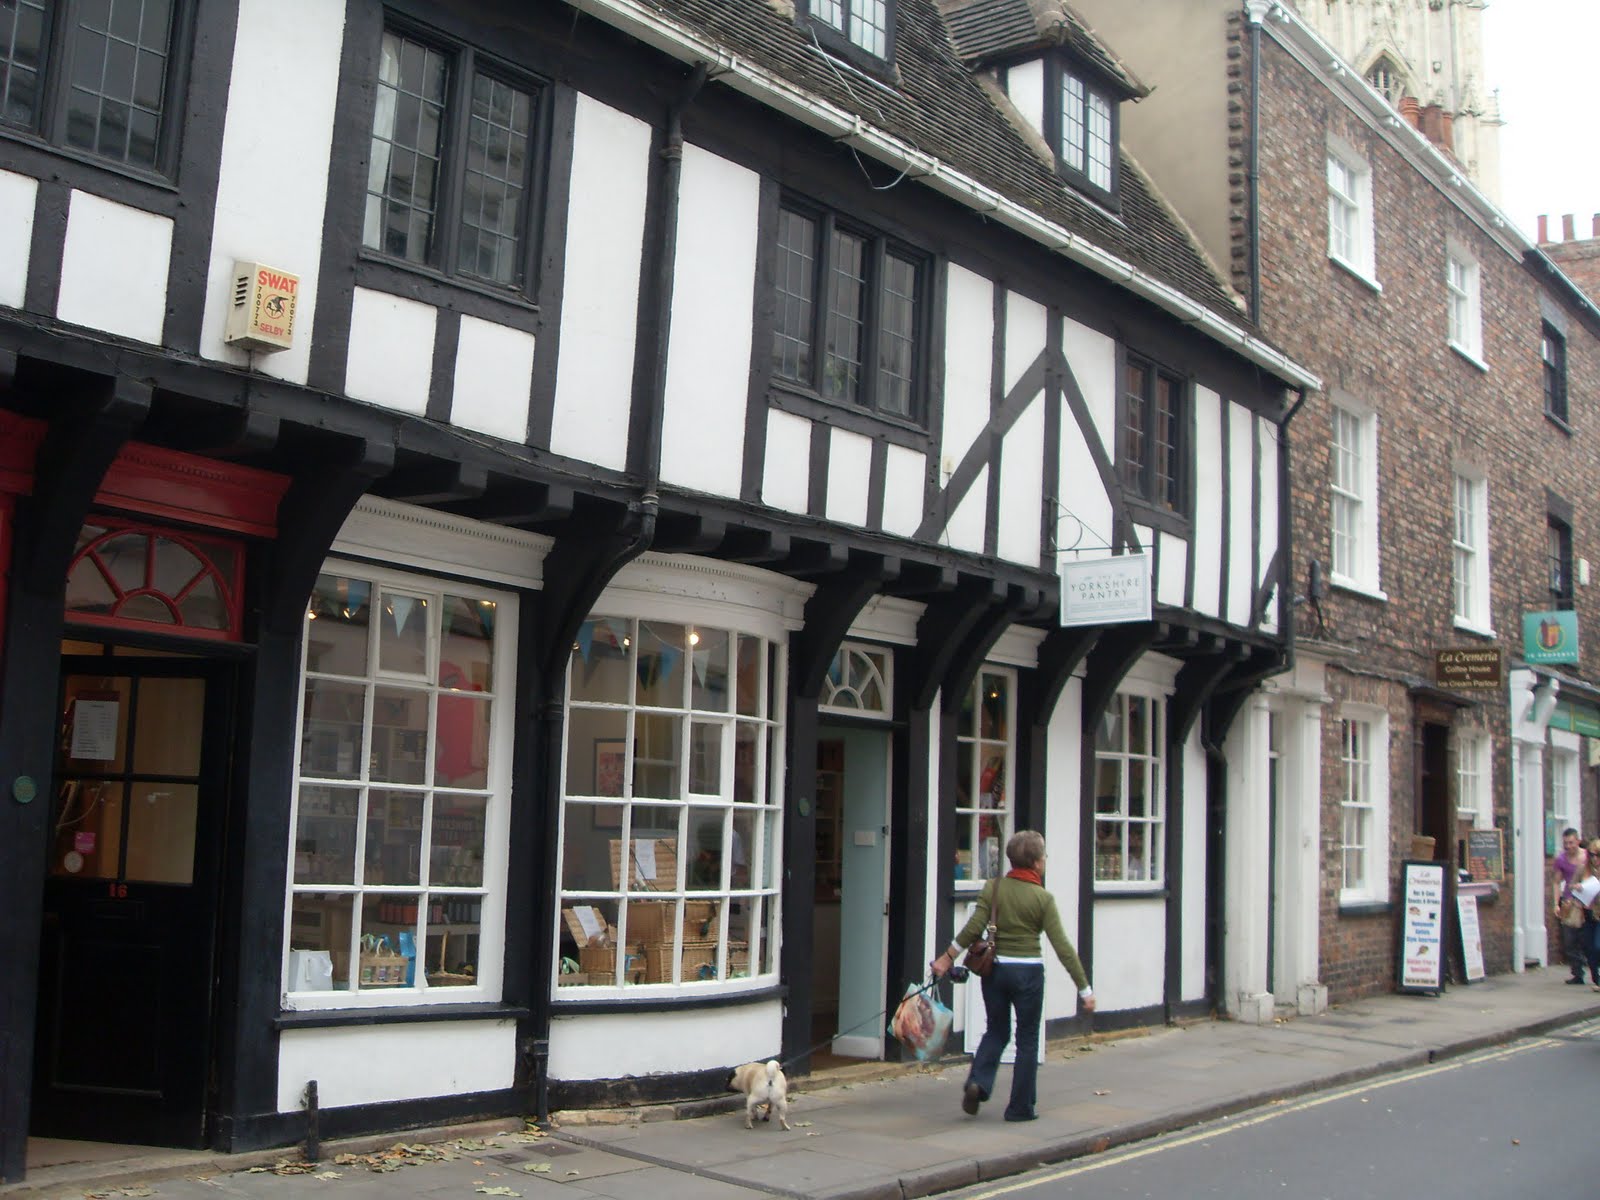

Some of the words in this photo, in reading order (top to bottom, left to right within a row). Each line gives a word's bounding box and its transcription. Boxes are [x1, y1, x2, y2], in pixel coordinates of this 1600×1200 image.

[258, 270, 297, 294] SWAT
[259, 322, 285, 336] SELBY
[1071, 578, 1139, 592] YORKSHIRE
[1081, 589, 1127, 600] PANTRY
[1439, 652, 1453, 662] La
[1454, 651, 1498, 663] Cremeria
[109, 883, 128, 898] 16
